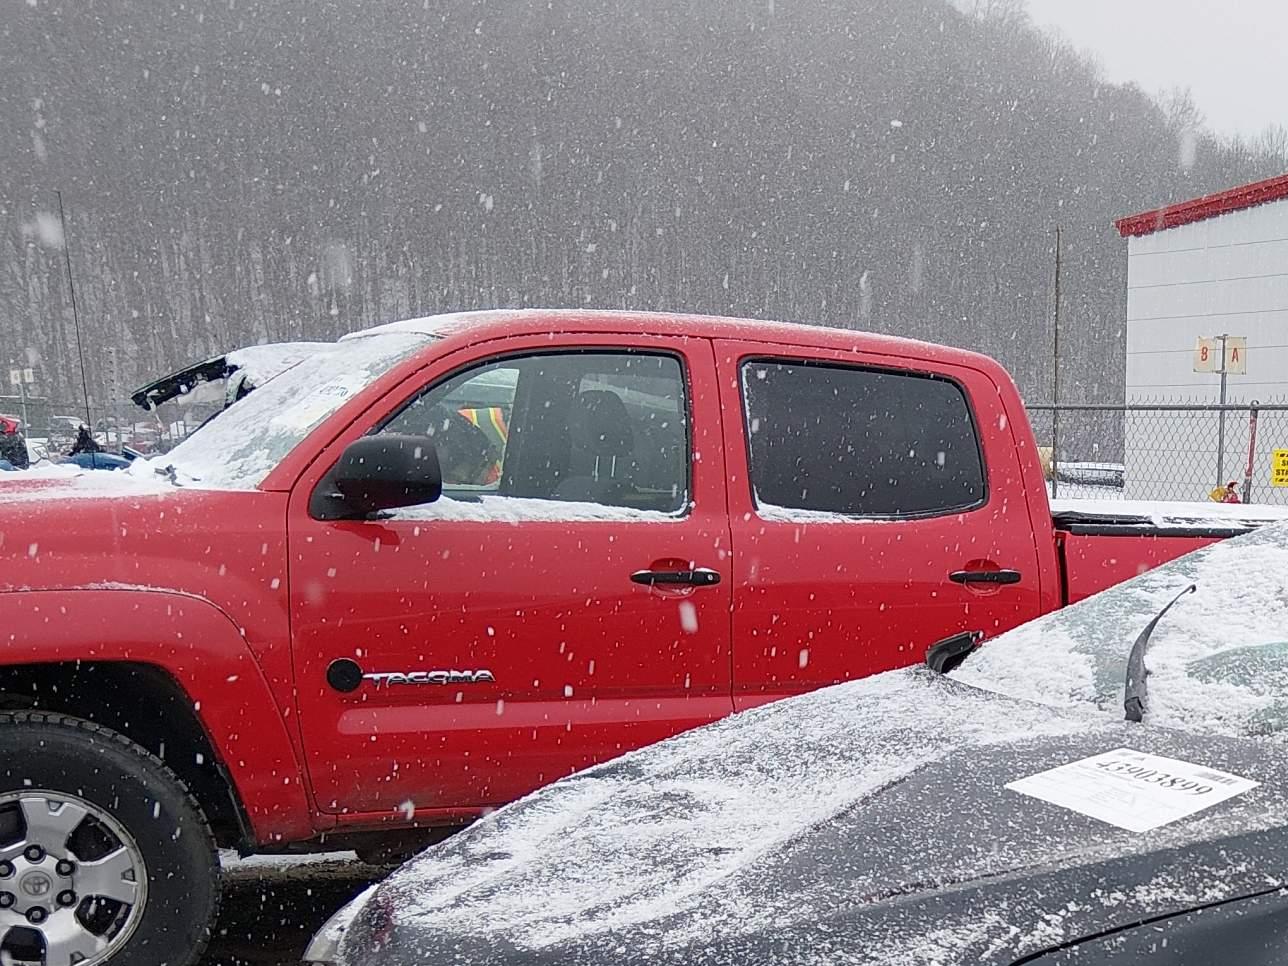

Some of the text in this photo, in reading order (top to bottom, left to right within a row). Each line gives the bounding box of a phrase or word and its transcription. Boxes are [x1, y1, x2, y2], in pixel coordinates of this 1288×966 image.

[1231, 347, 1239, 363] A
[362, 669, 496, 690] TACOMA
[1095, 760, 1214, 796] 43903899
